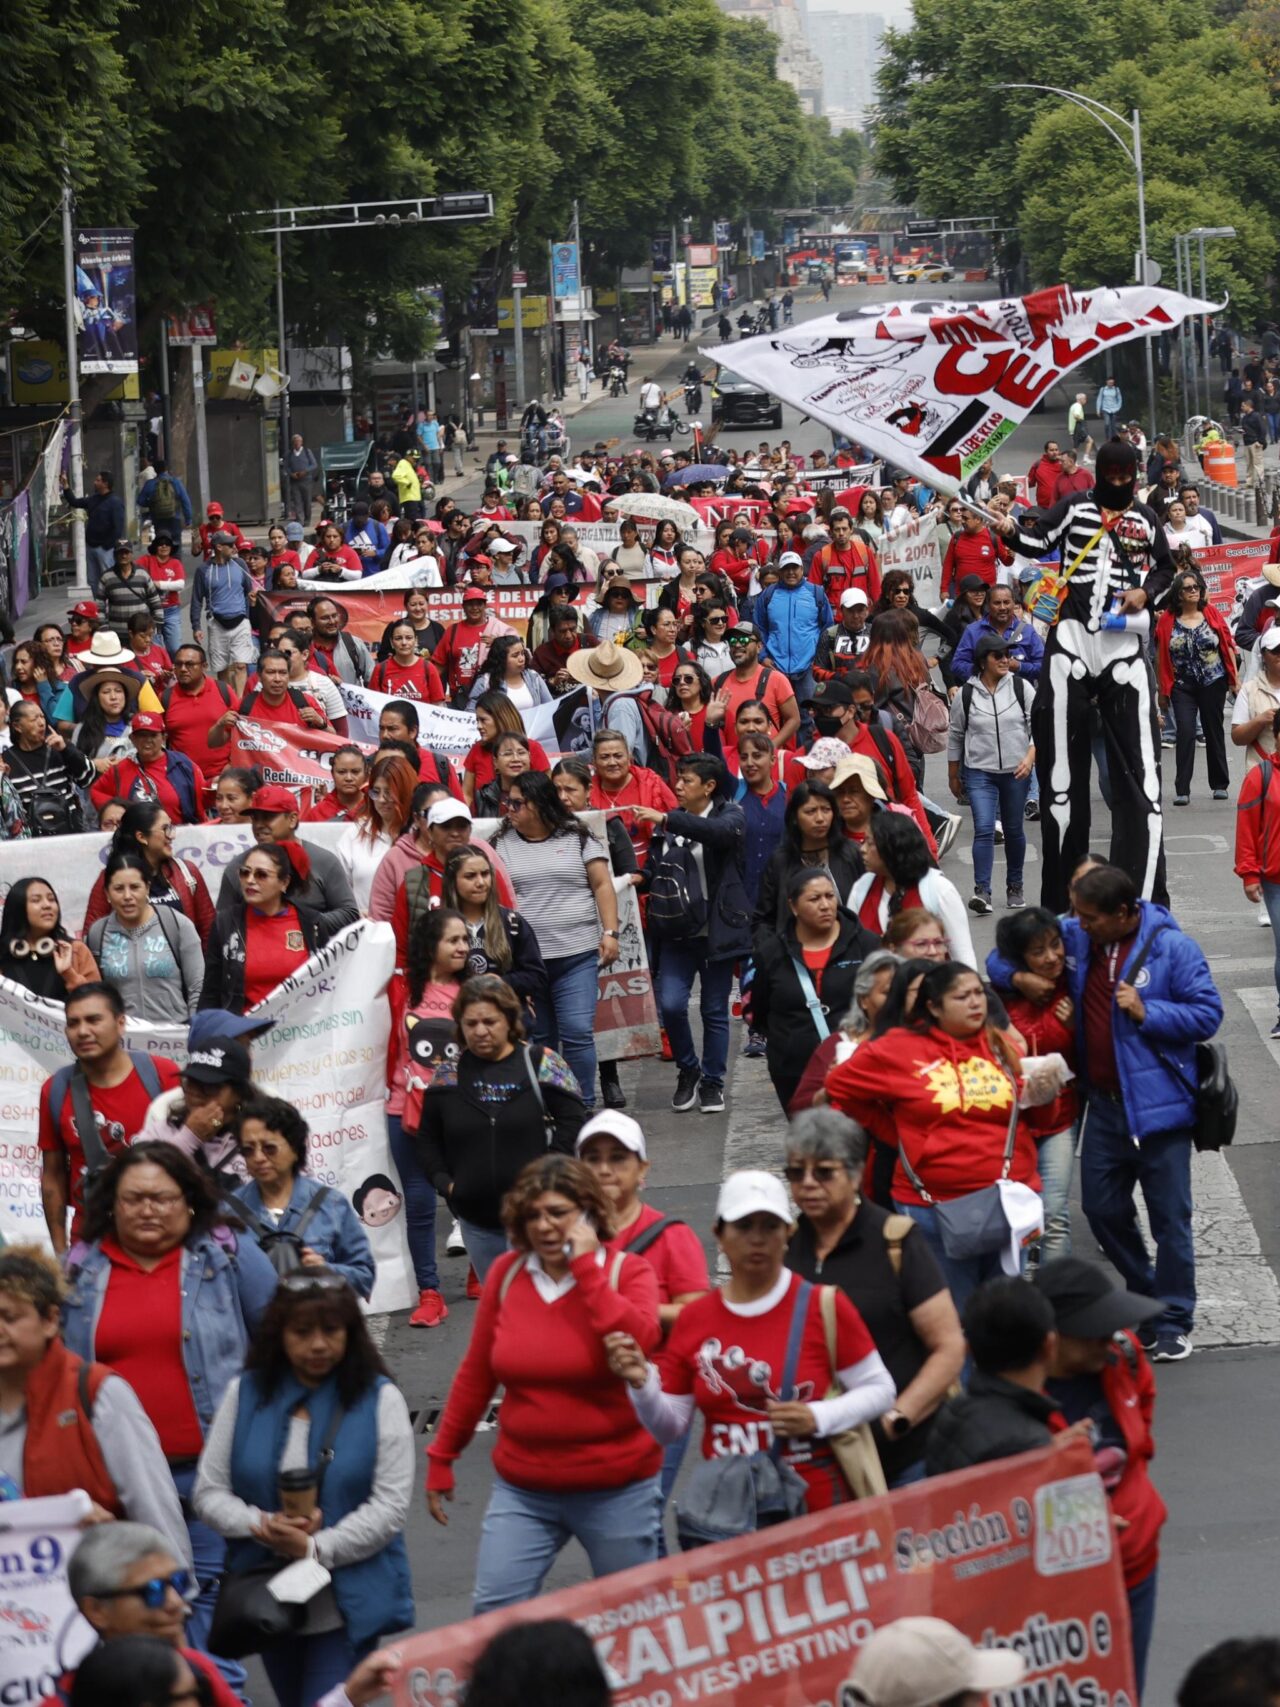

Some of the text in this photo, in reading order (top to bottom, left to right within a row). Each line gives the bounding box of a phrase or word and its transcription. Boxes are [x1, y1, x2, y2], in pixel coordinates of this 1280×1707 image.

[956, 412, 1003, 457] LIBERTAD
[905, 543, 936, 562] 2007
[500, 590, 521, 603] DE
[271, 1015, 339, 1048] pensiones
[341, 1009, 364, 1025] sin
[30, 1535, 61, 1575] 9
[895, 1503, 1010, 1572] Sección
[1011, 1496, 1033, 1538] 9
[690, 1574, 724, 1603] DE
[728, 1564, 763, 1592] LA
[766, 1529, 881, 1581] ESCUELA
[675, 1618, 876, 1701] VESPERTINO
